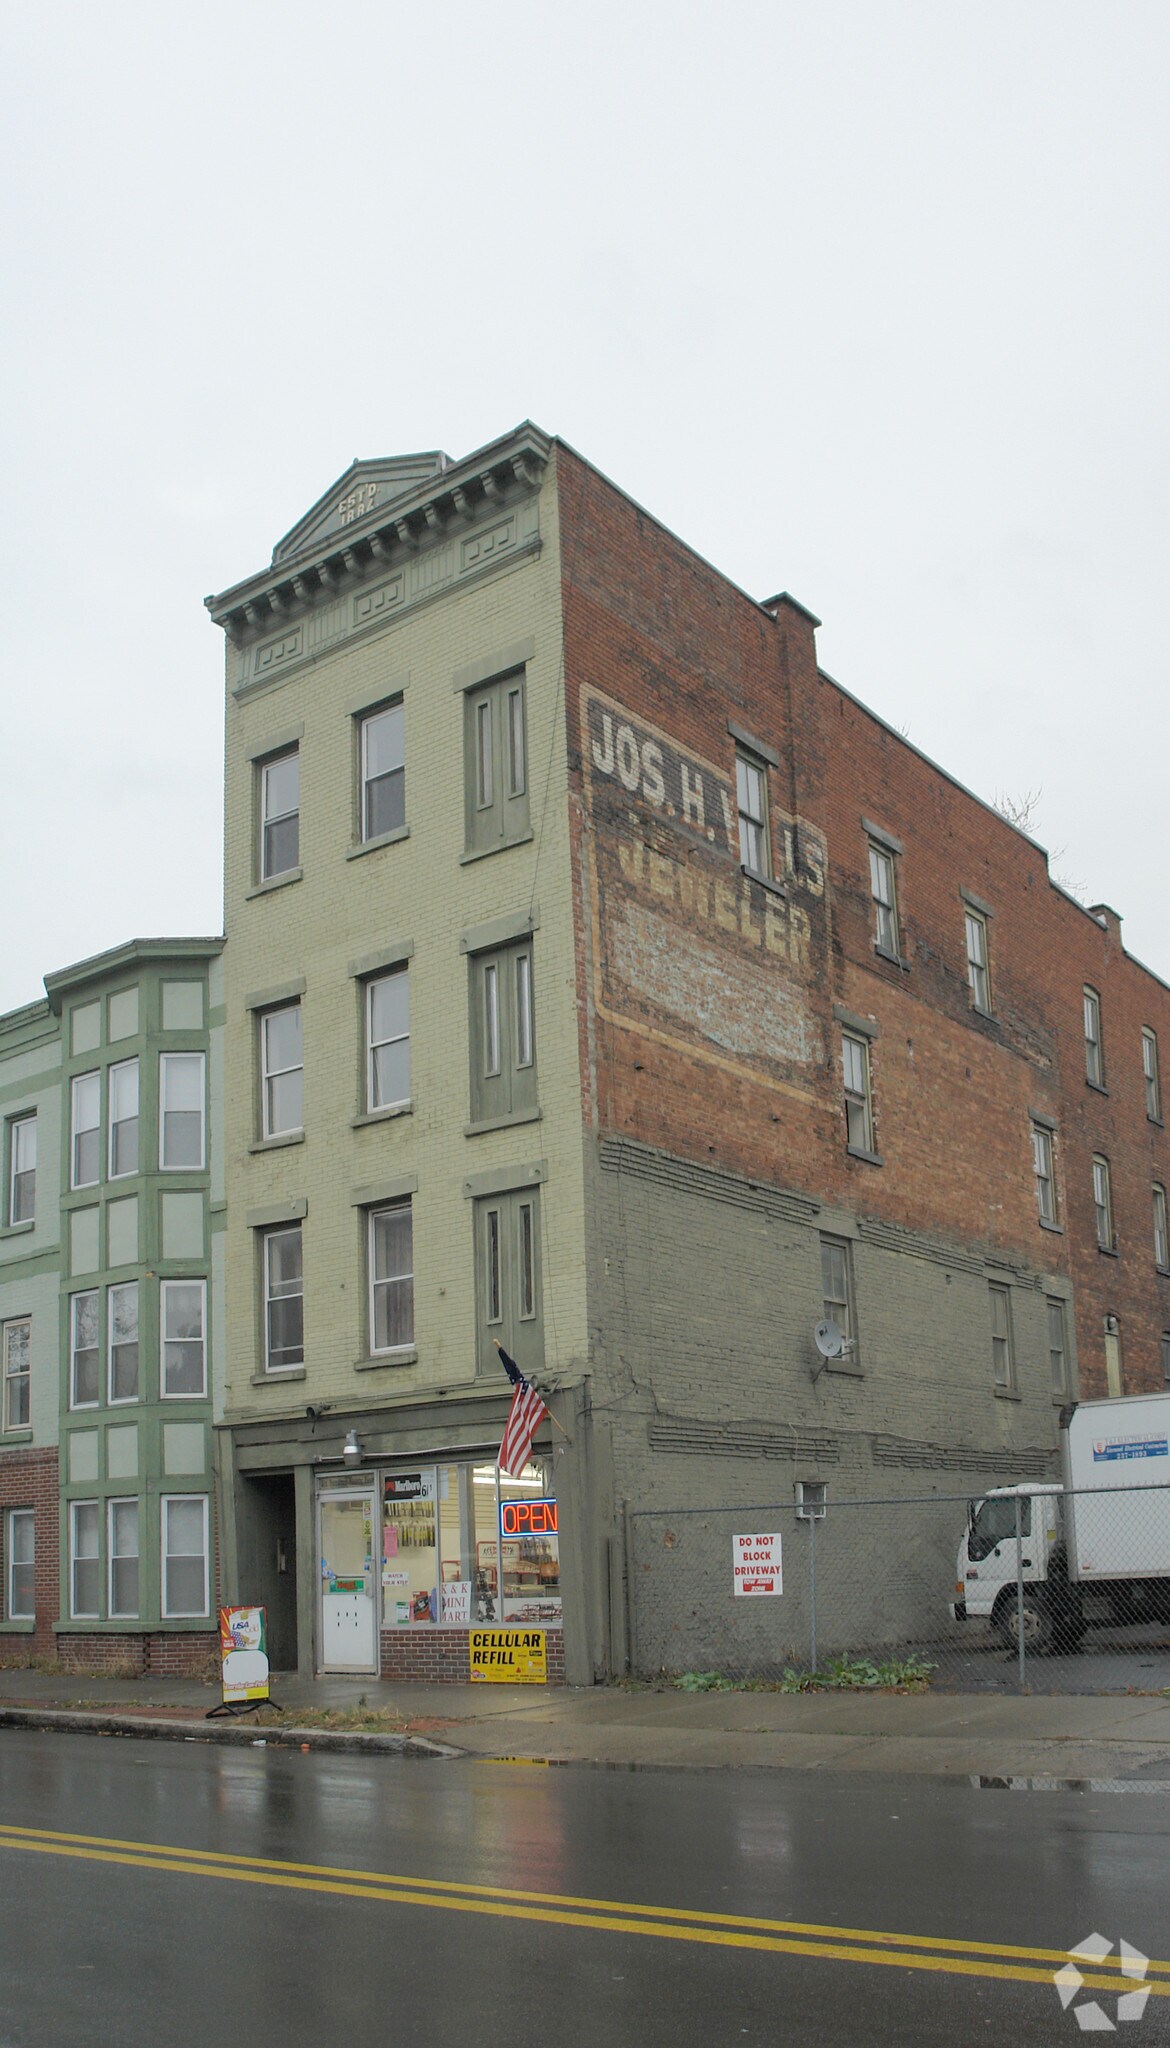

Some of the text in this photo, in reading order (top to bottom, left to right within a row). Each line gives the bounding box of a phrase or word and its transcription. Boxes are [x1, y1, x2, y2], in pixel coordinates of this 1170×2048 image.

[395, 1480, 421, 1492] Marlboro
[503, 1503, 559, 1533] OPEN
[739, 1536, 774, 1547] DO NOT
[743, 1551, 771, 1561] BLOCK
[735, 1565, 781, 1576] DRIVEWAY
[441, 1583, 468, 1594] K & K
[232, 1621, 249, 1631] USA
[473, 1633, 541, 1648] CELLULAR
[473, 1650, 515, 1665] REFILL
